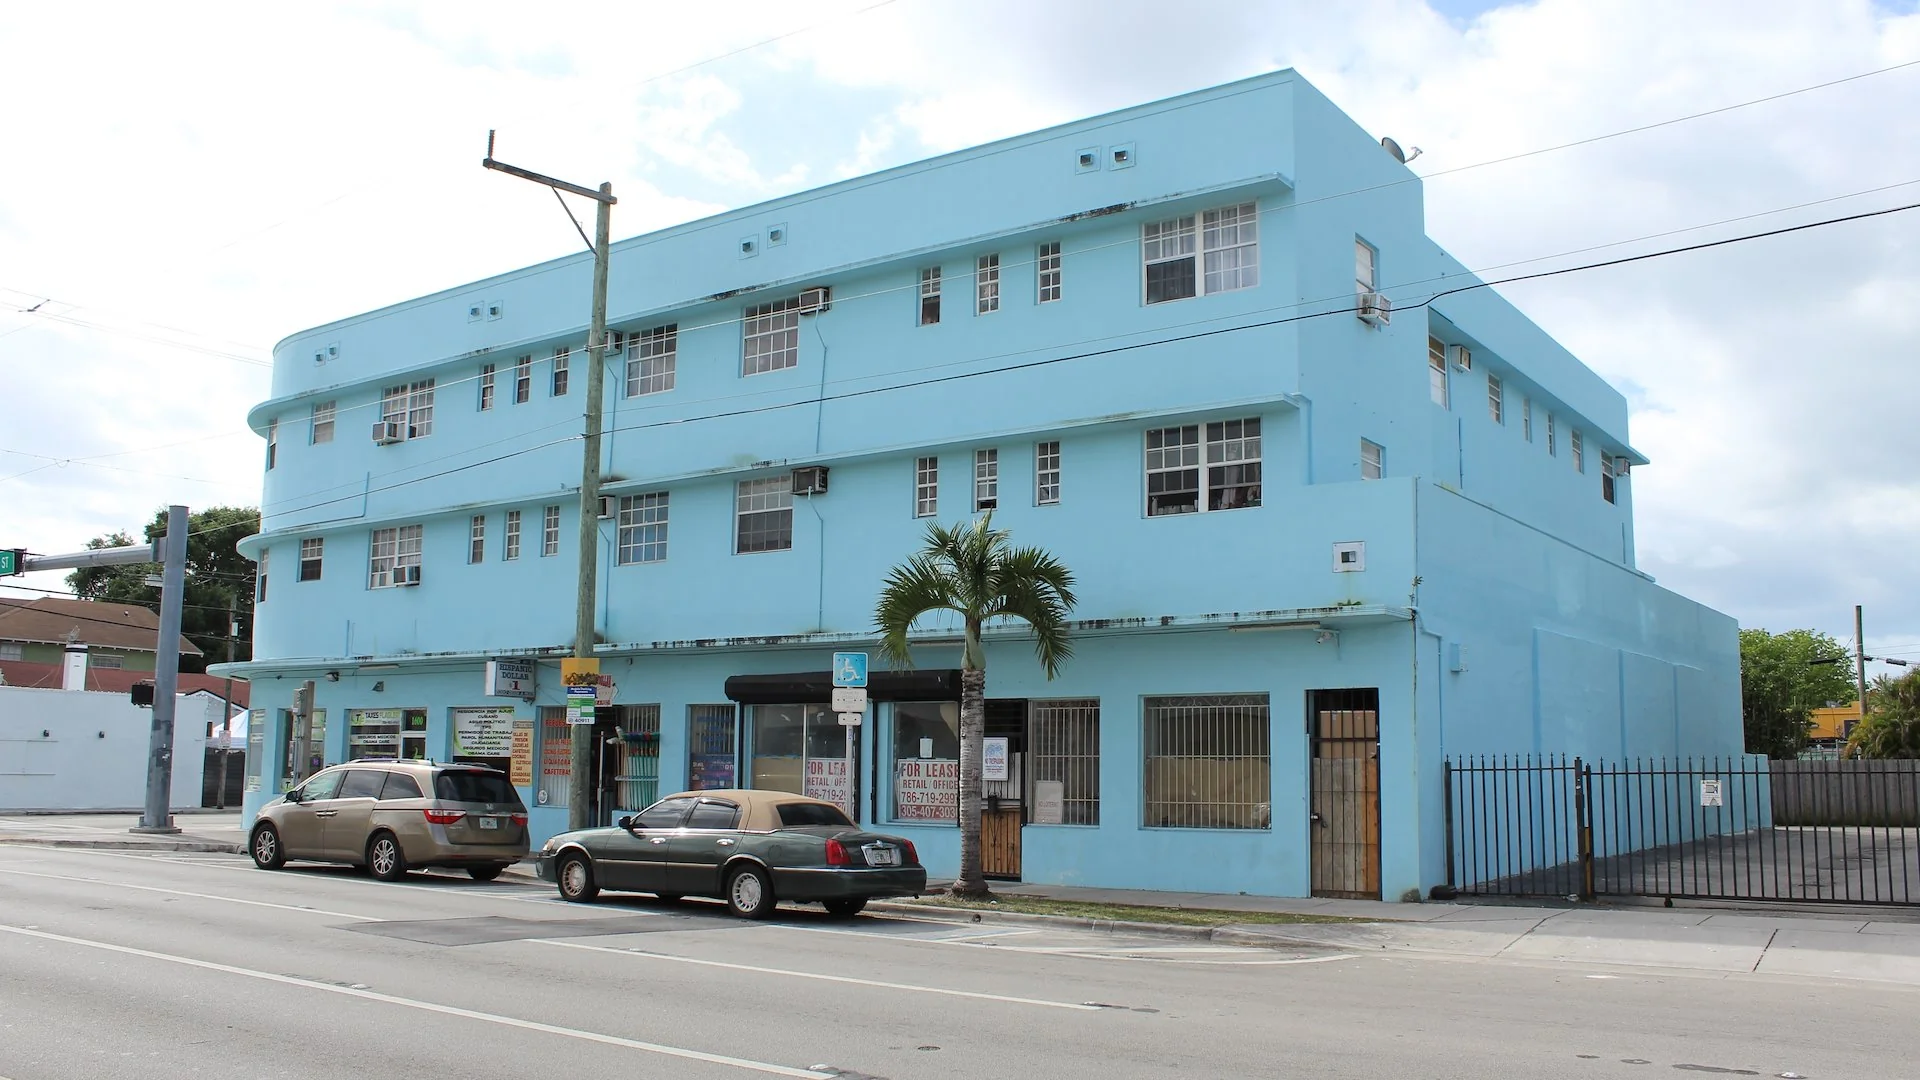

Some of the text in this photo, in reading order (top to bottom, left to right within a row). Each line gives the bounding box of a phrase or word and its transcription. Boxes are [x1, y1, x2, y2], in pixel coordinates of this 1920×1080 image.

[1, 556, 9, 569] ST
[499, 664, 533, 673] HISPANIC
[502, 672, 529, 680] DOLLAR
[901, 762, 959, 778] FOR LEASE
[807, 777, 830, 787] RETAIL
[903, 780, 928, 789] RETAIL
[932, 780, 958, 790] OFFICE
